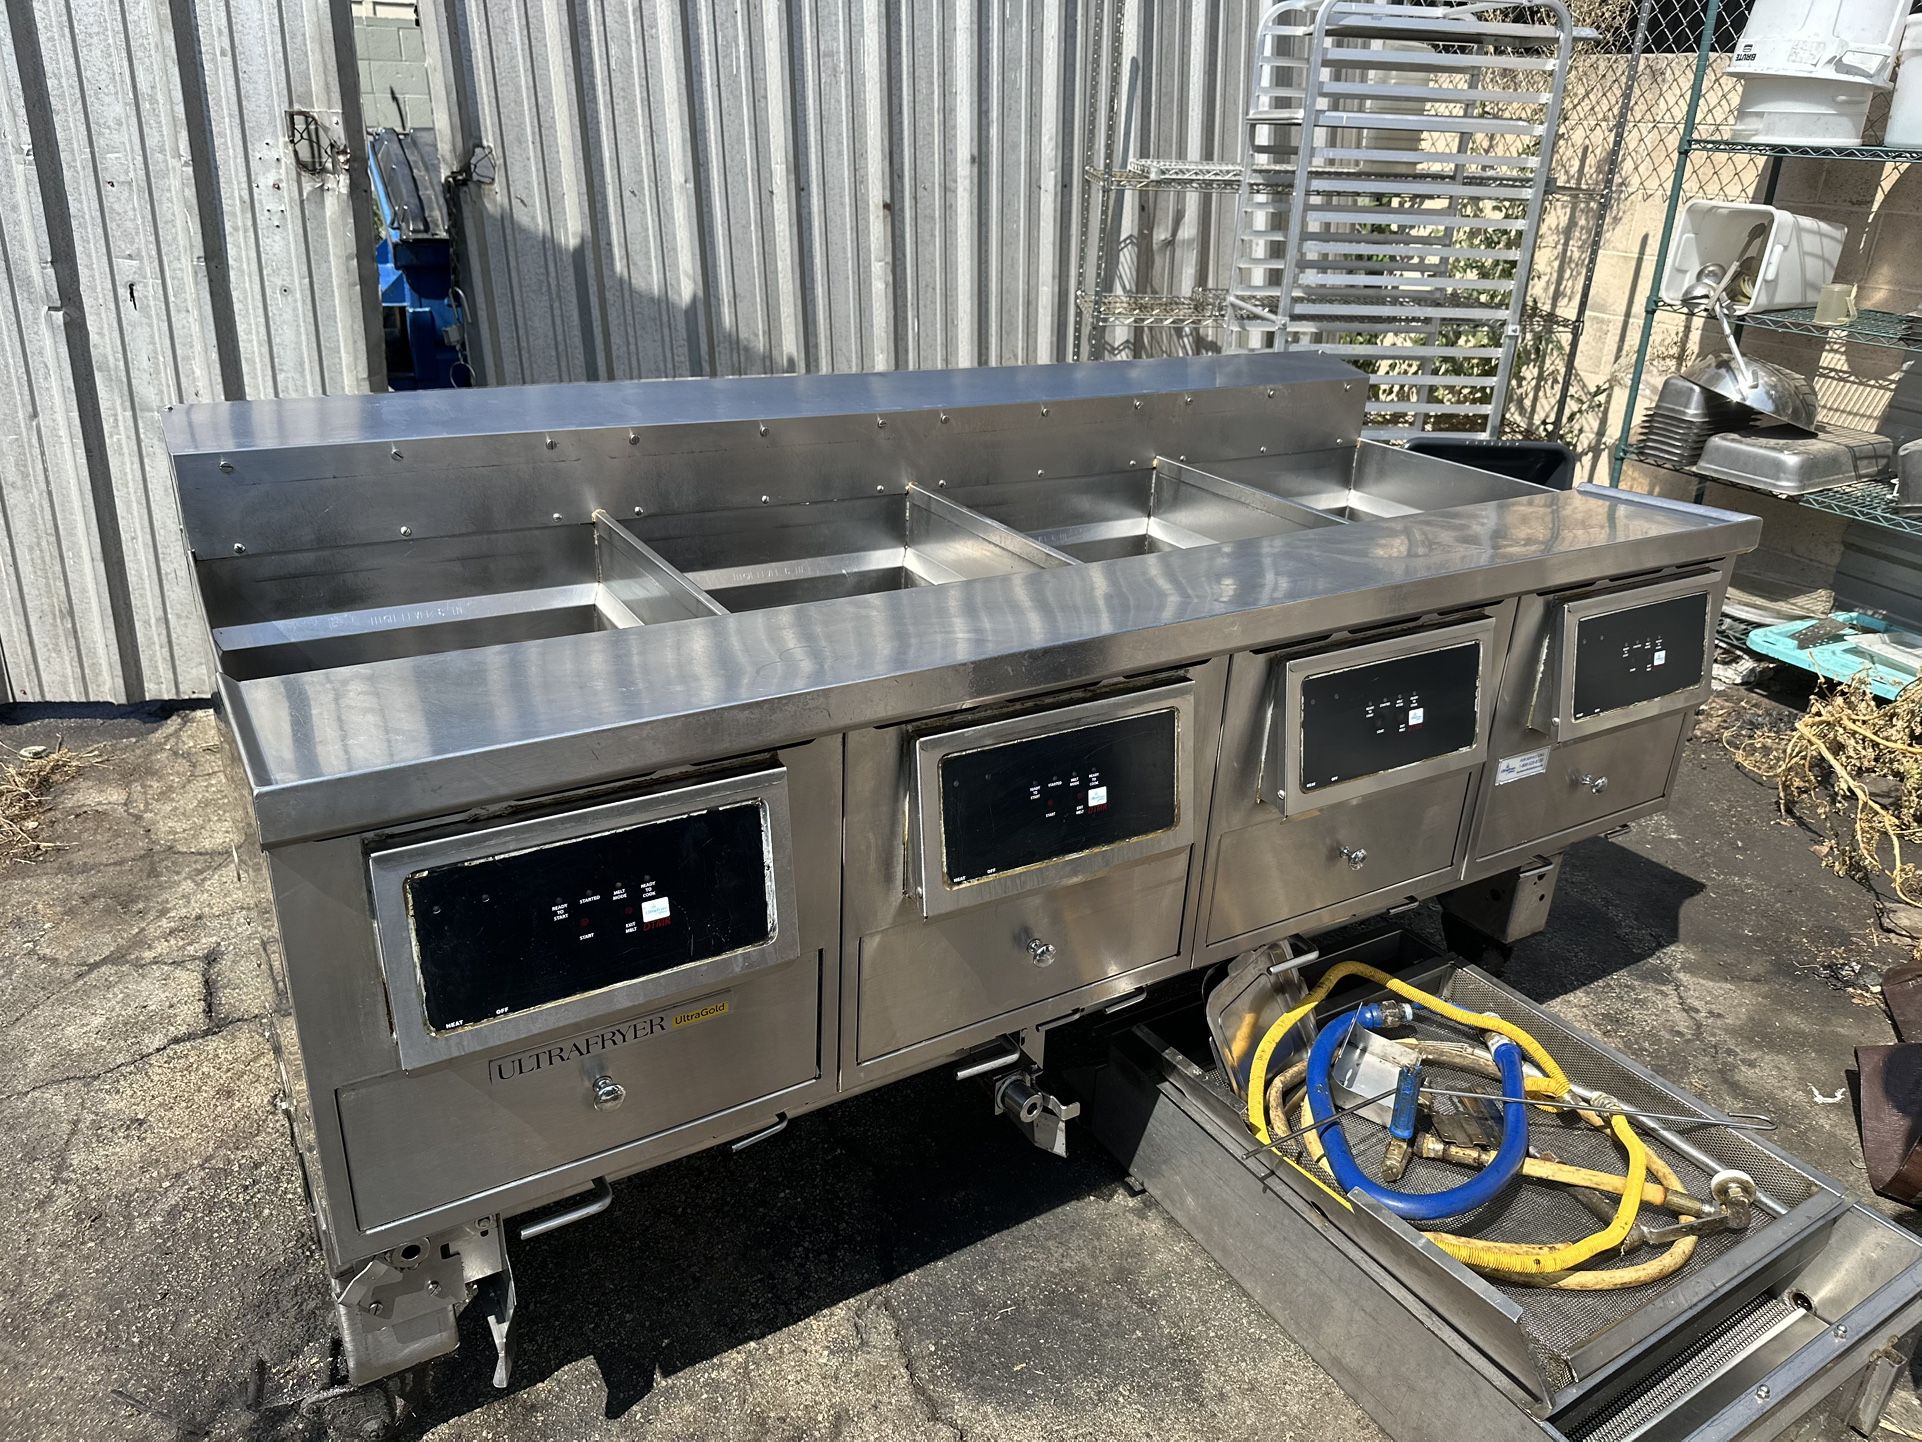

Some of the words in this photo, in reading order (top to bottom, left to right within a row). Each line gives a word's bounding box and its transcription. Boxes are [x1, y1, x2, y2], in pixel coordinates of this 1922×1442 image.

[1735, 53, 1757, 62] BRUTE
[640, 881, 656, 889] READY
[613, 888, 626, 896] MELT
[579, 894, 601, 905] STARTED
[612, 893, 628, 901] MODE
[551, 903, 568, 912] READY
[553, 913, 569, 922] START
[579, 932, 595, 941] START
[495, 1006, 509, 1015] OFF
[445, 1019, 464, 1029] HEAT
[497, 1016, 666, 1080] ULTRAFRYER
[674, 1003, 725, 1025] UltraGold
